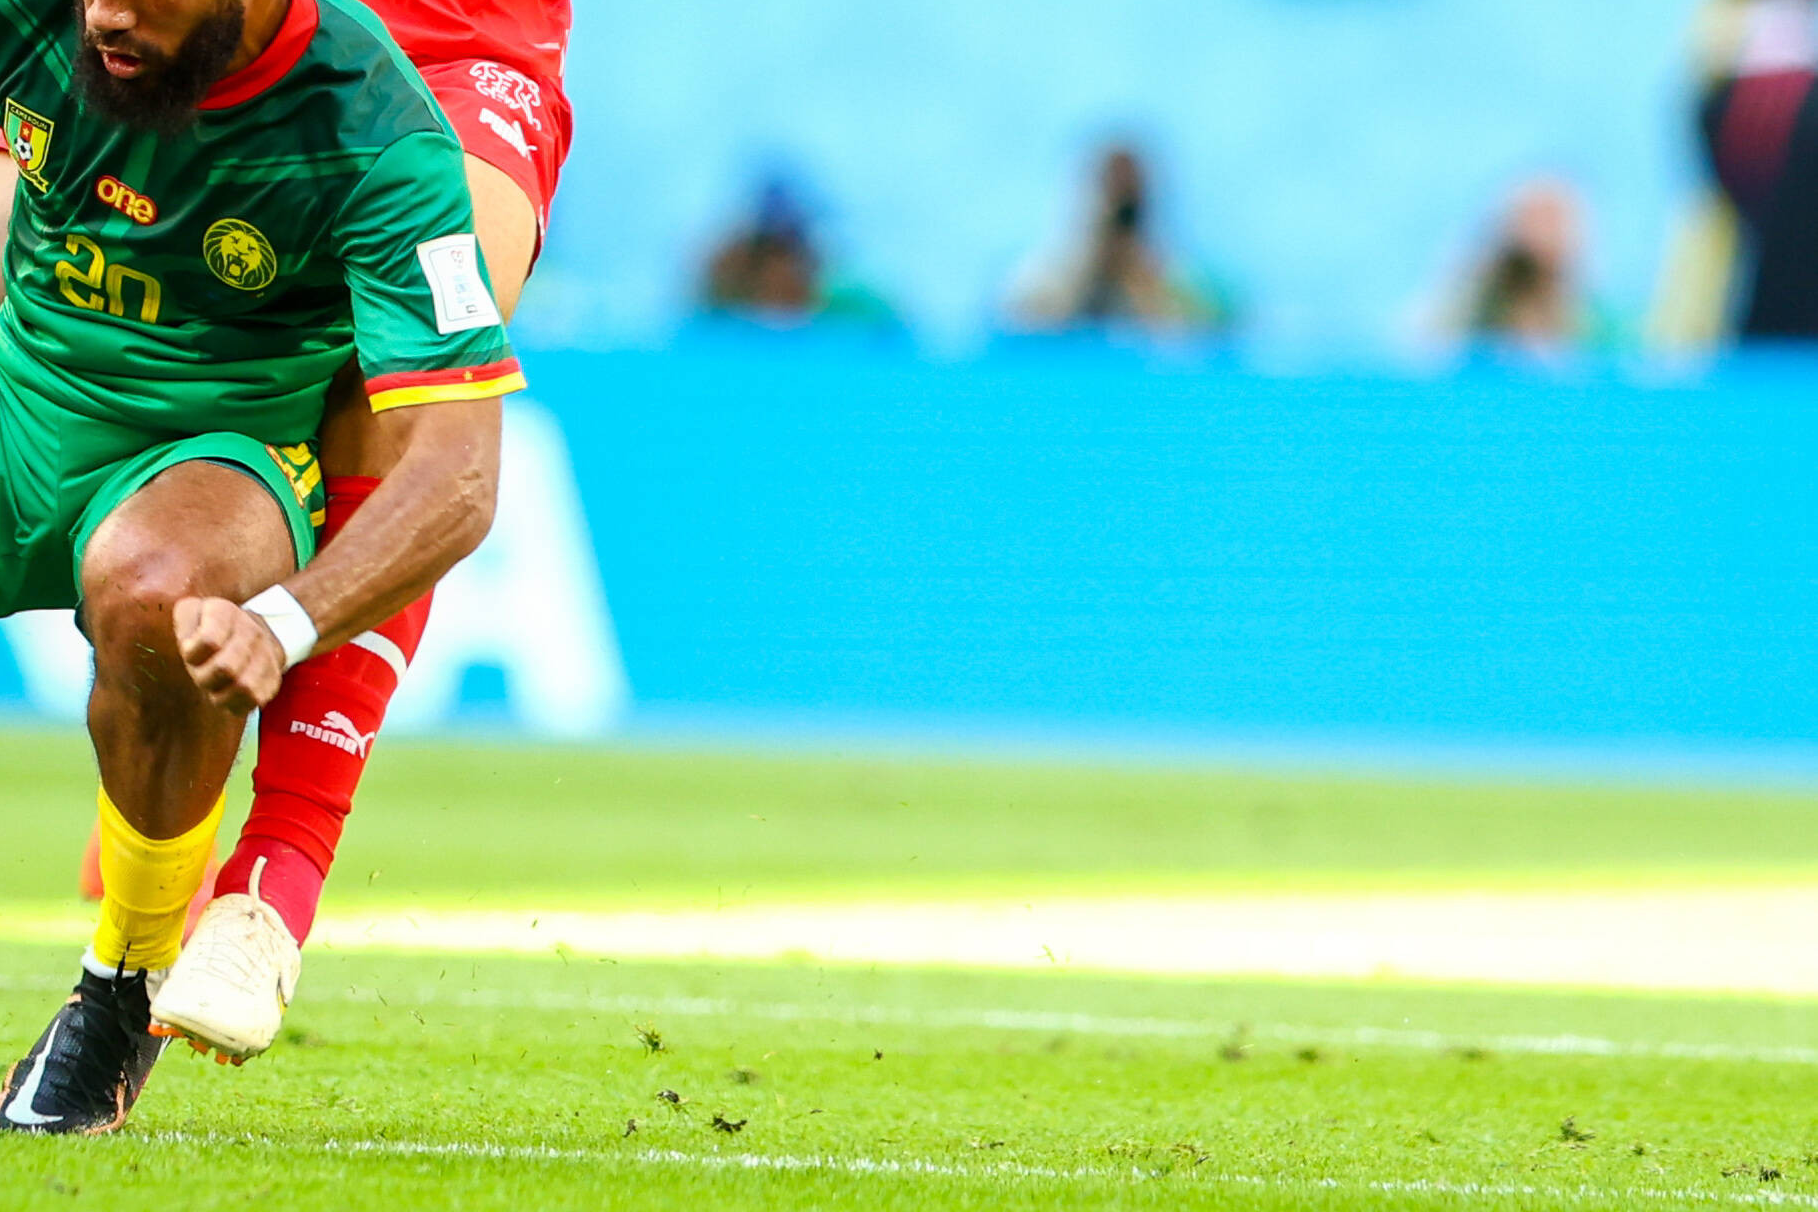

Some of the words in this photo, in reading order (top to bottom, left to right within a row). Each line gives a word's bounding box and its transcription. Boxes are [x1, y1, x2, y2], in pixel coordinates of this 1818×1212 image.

[97, 178, 154, 224] one
[55, 234, 161, 323] 20
[290, 720, 359, 756] PUMA
